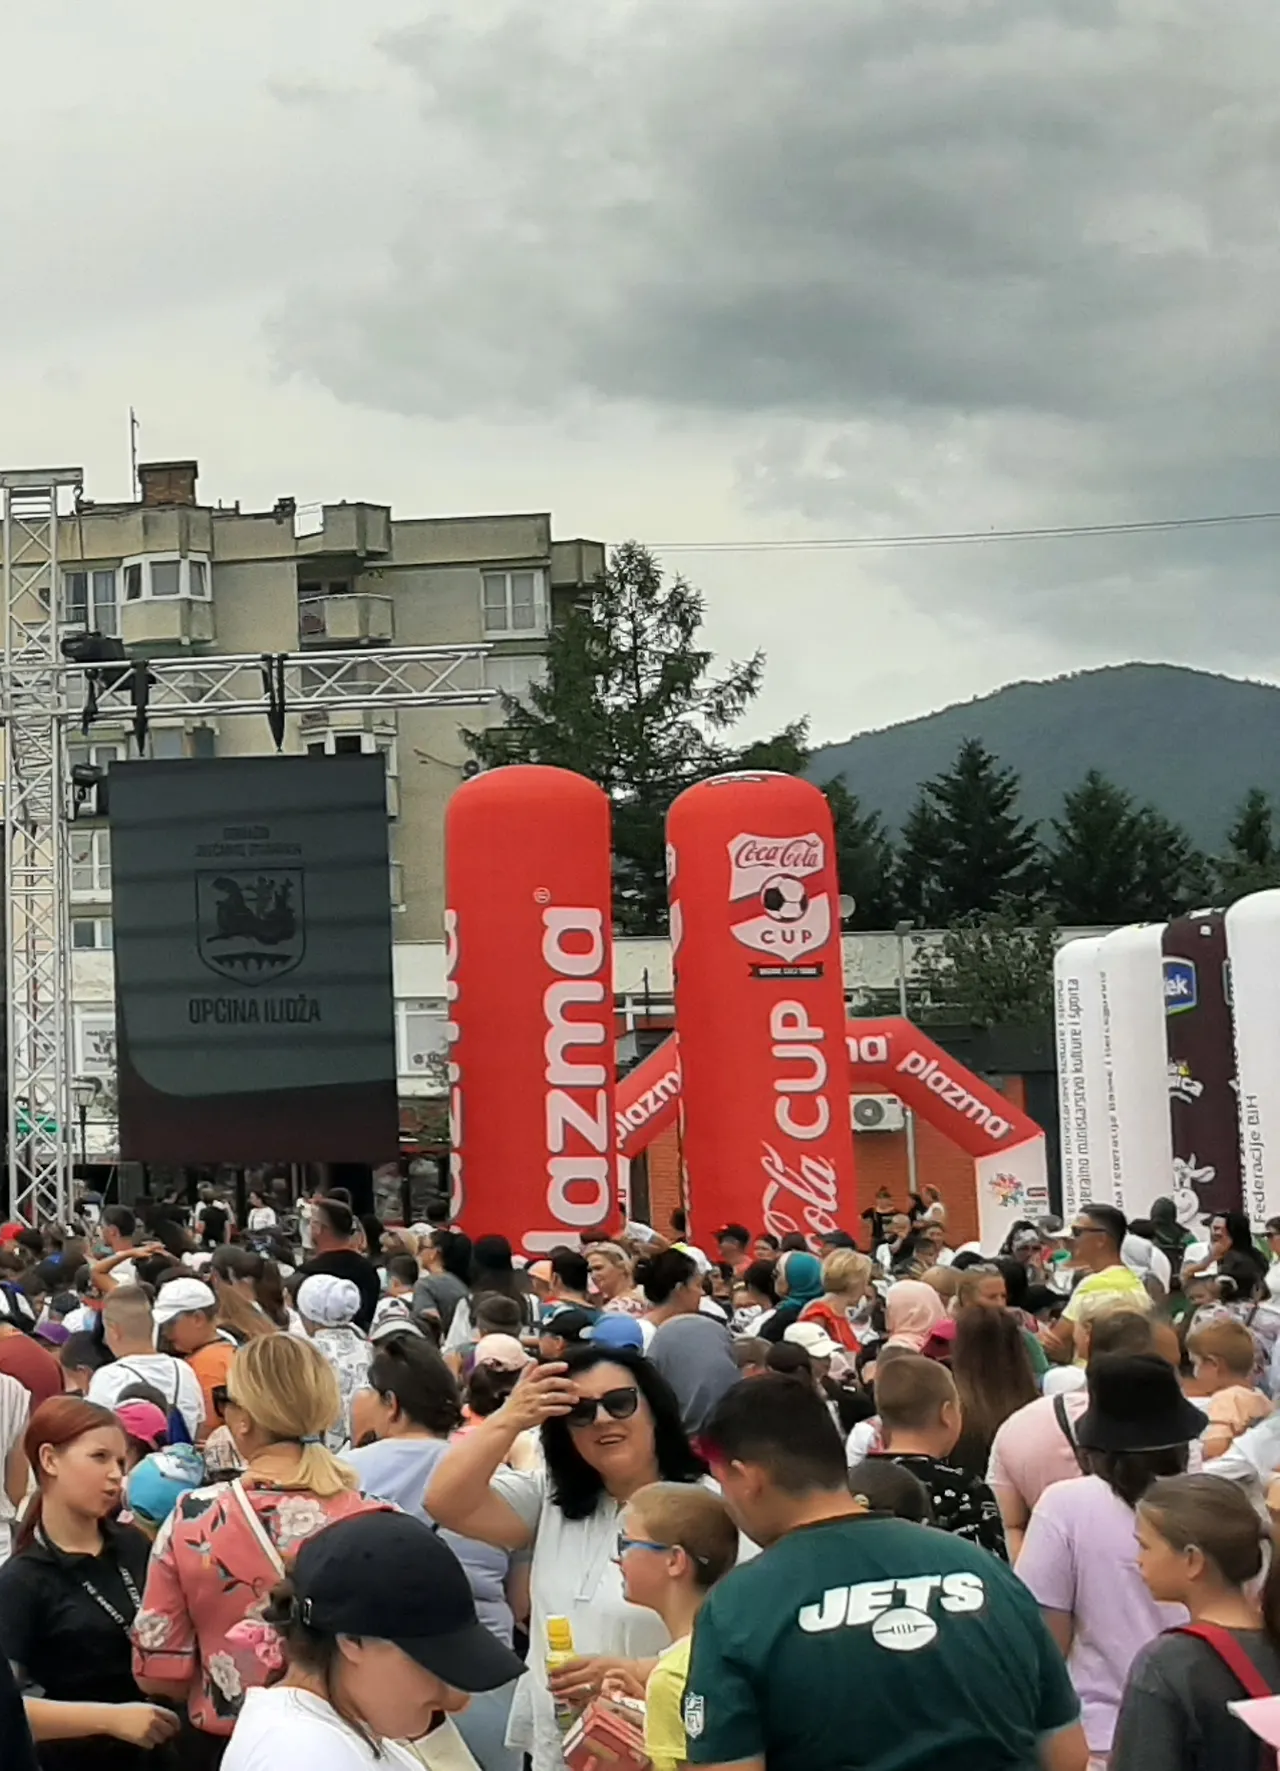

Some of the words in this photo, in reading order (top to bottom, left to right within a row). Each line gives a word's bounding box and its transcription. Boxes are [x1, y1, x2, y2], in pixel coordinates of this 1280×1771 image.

[761, 931, 813, 944] CUP
[264, 993, 322, 1023] ILIDŽA
[522, 906, 607, 1254] lazma
[769, 999, 831, 1141] CUP
[896, 1050, 1012, 1140] plazma
[798, 1572, 985, 1633] JETS
